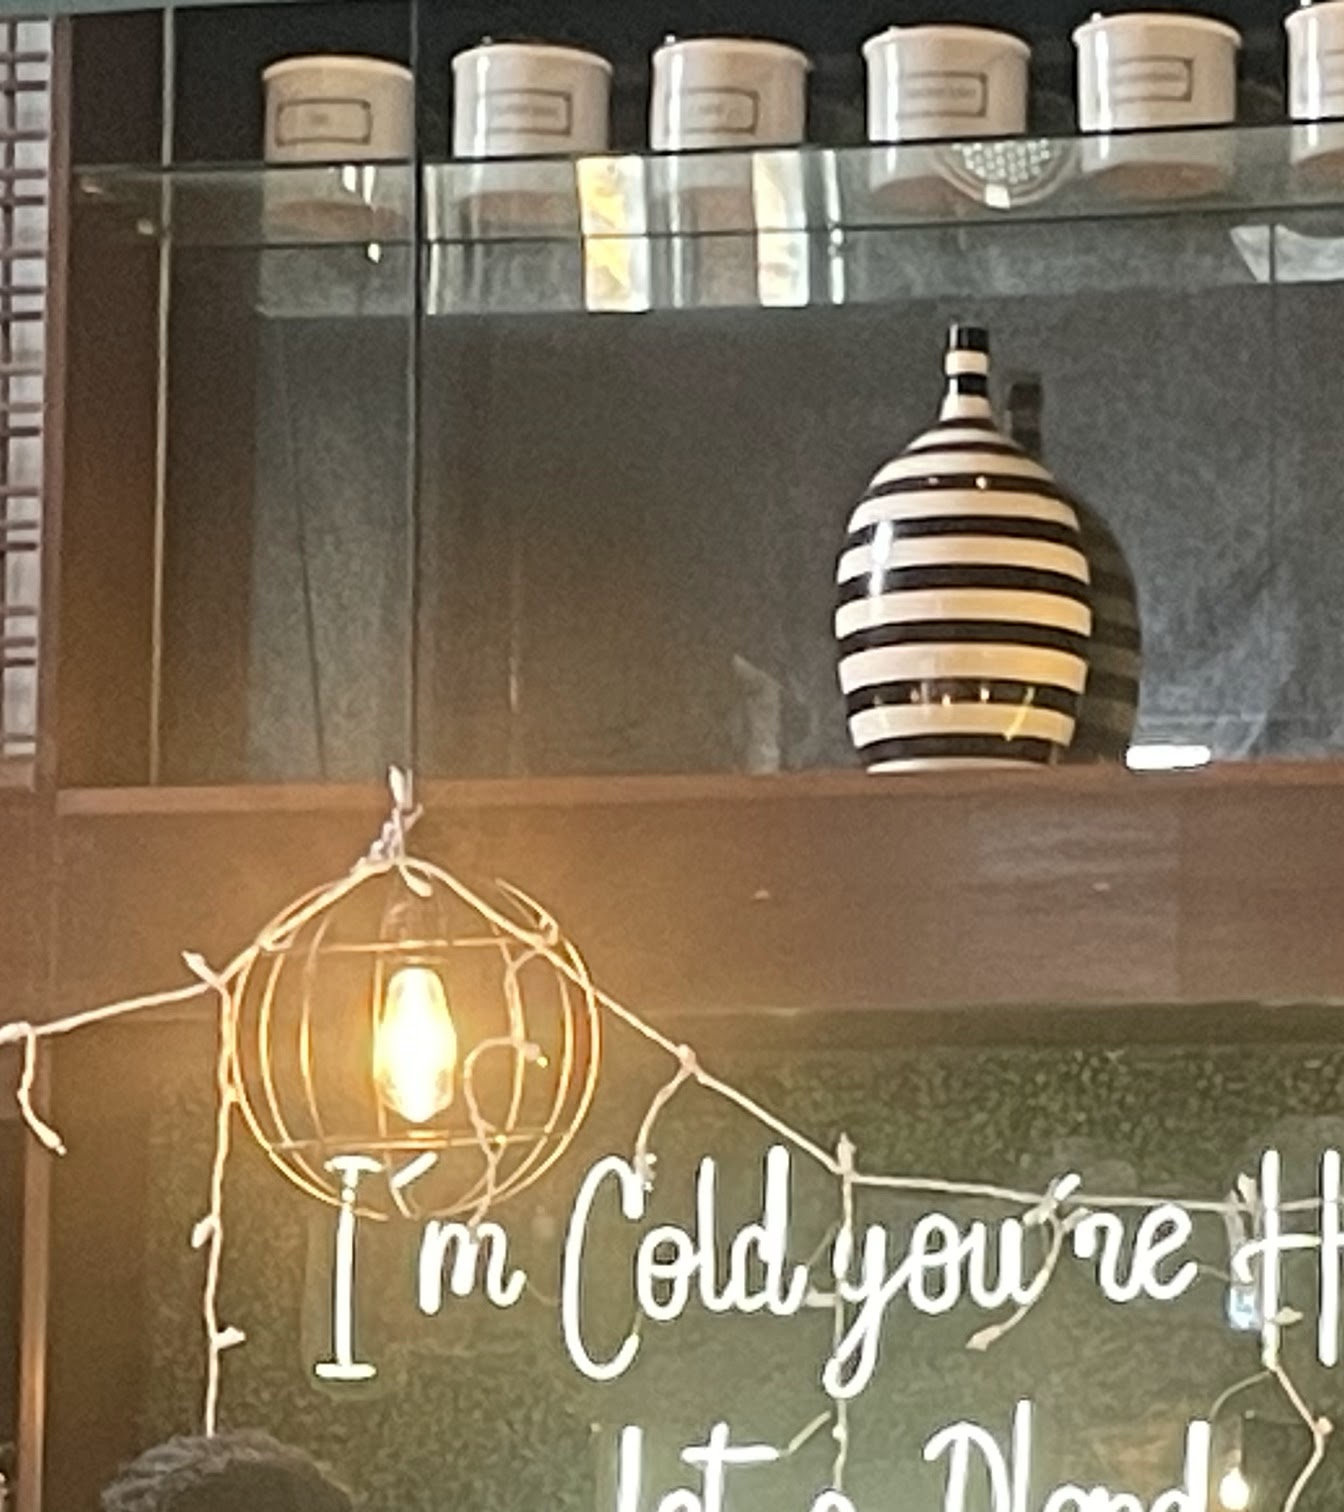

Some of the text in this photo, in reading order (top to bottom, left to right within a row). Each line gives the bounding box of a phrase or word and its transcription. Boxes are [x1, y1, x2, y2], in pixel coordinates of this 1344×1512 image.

[314, 1150, 527, 1380] I'm
[562, 1145, 808, 1381] Cold
[822, 1172, 1199, 1399] you're
